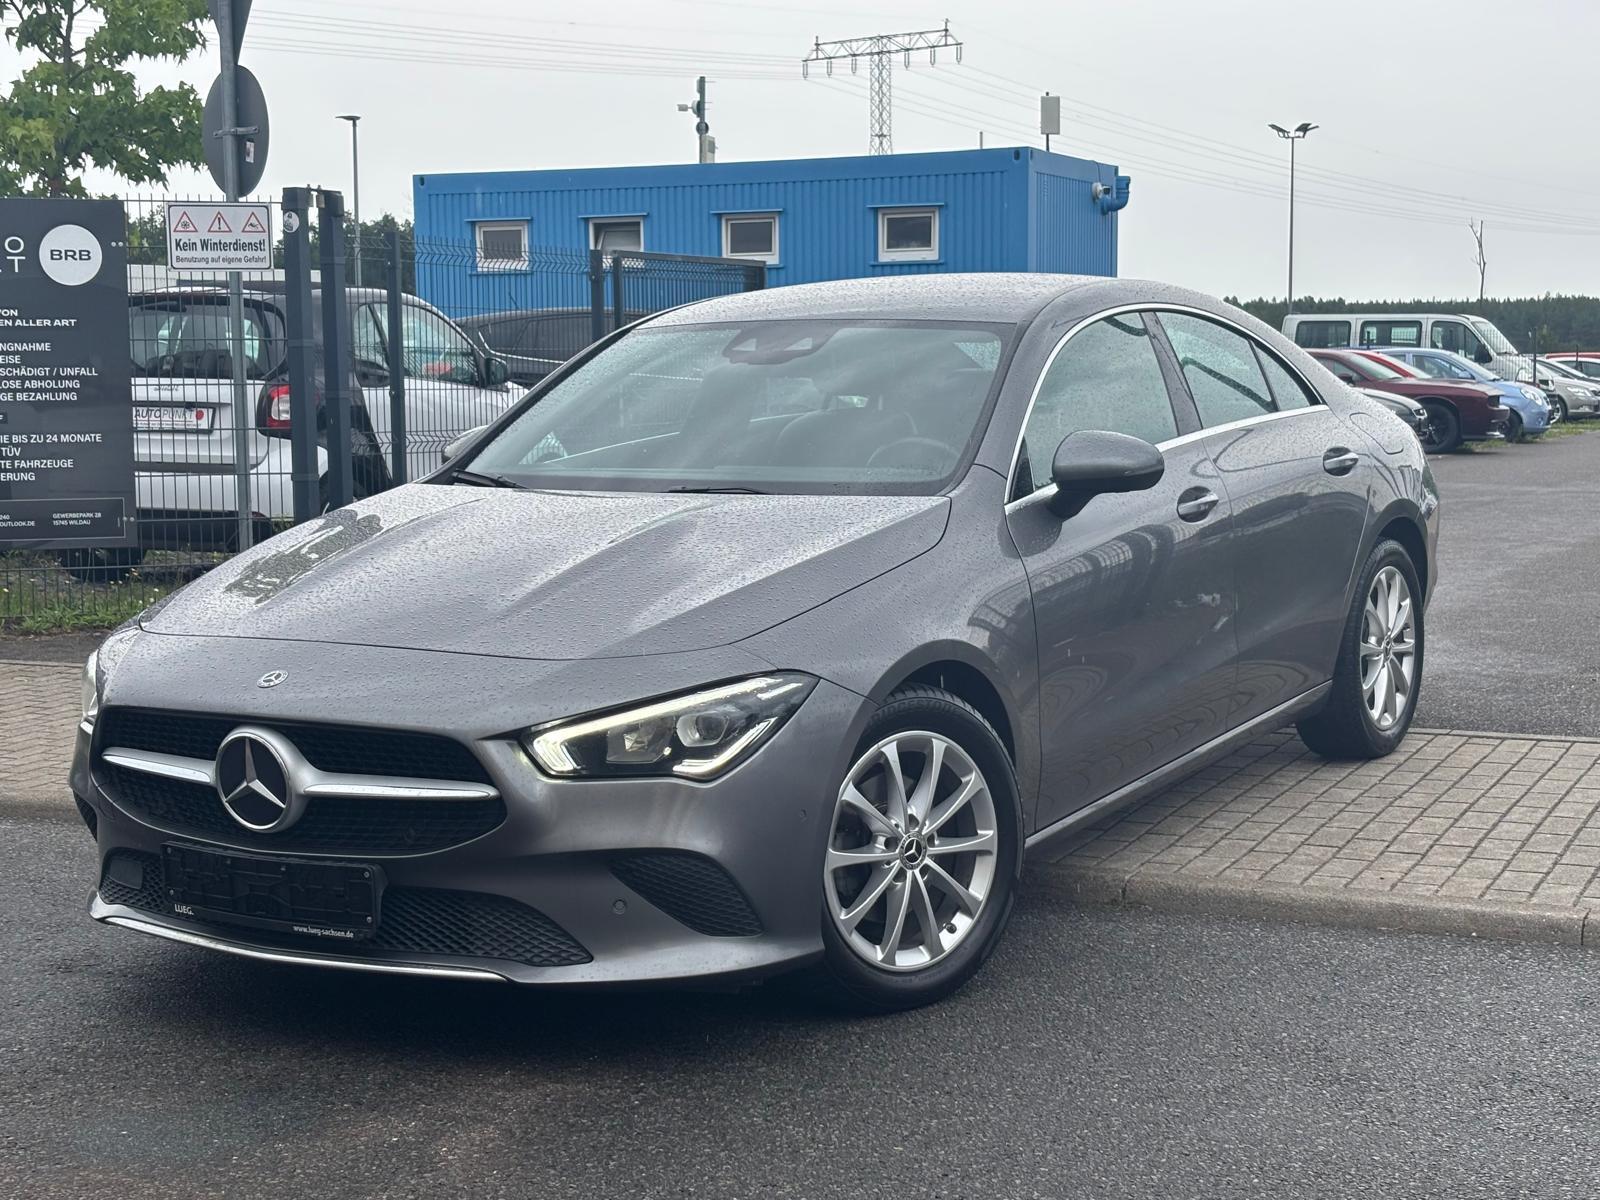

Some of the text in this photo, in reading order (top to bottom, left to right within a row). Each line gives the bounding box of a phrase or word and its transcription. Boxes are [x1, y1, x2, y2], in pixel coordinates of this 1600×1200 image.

[175, 238, 266, 252] Kein Winterdienst!
[50, 249, 92, 261] BRB
[176, 255, 267, 265] Benutzung auf eigene Gefahr!
[0, 308, 19, 317] ON
[15, 319, 52, 327] ALLER
[53, 319, 77, 327] ART
[0, 365, 98, 377] SCHÄDIGT / UNFALL
[24, 380, 81, 389] ABHOLUNG
[16, 392, 78, 401] BEZAHLUNG
[12, 434, 29, 443] BIS
[30, 433, 44, 443] ZU
[46, 433, 59, 443] 24
[60, 433, 102, 443] MONATE
[1, 445, 21, 457] TÜV
[14, 459, 74, 469] FAHRZEUGE
[0, 472, 36, 482] ERUNG
[292, 924, 355, 939] www.lueg-sachsen.de
